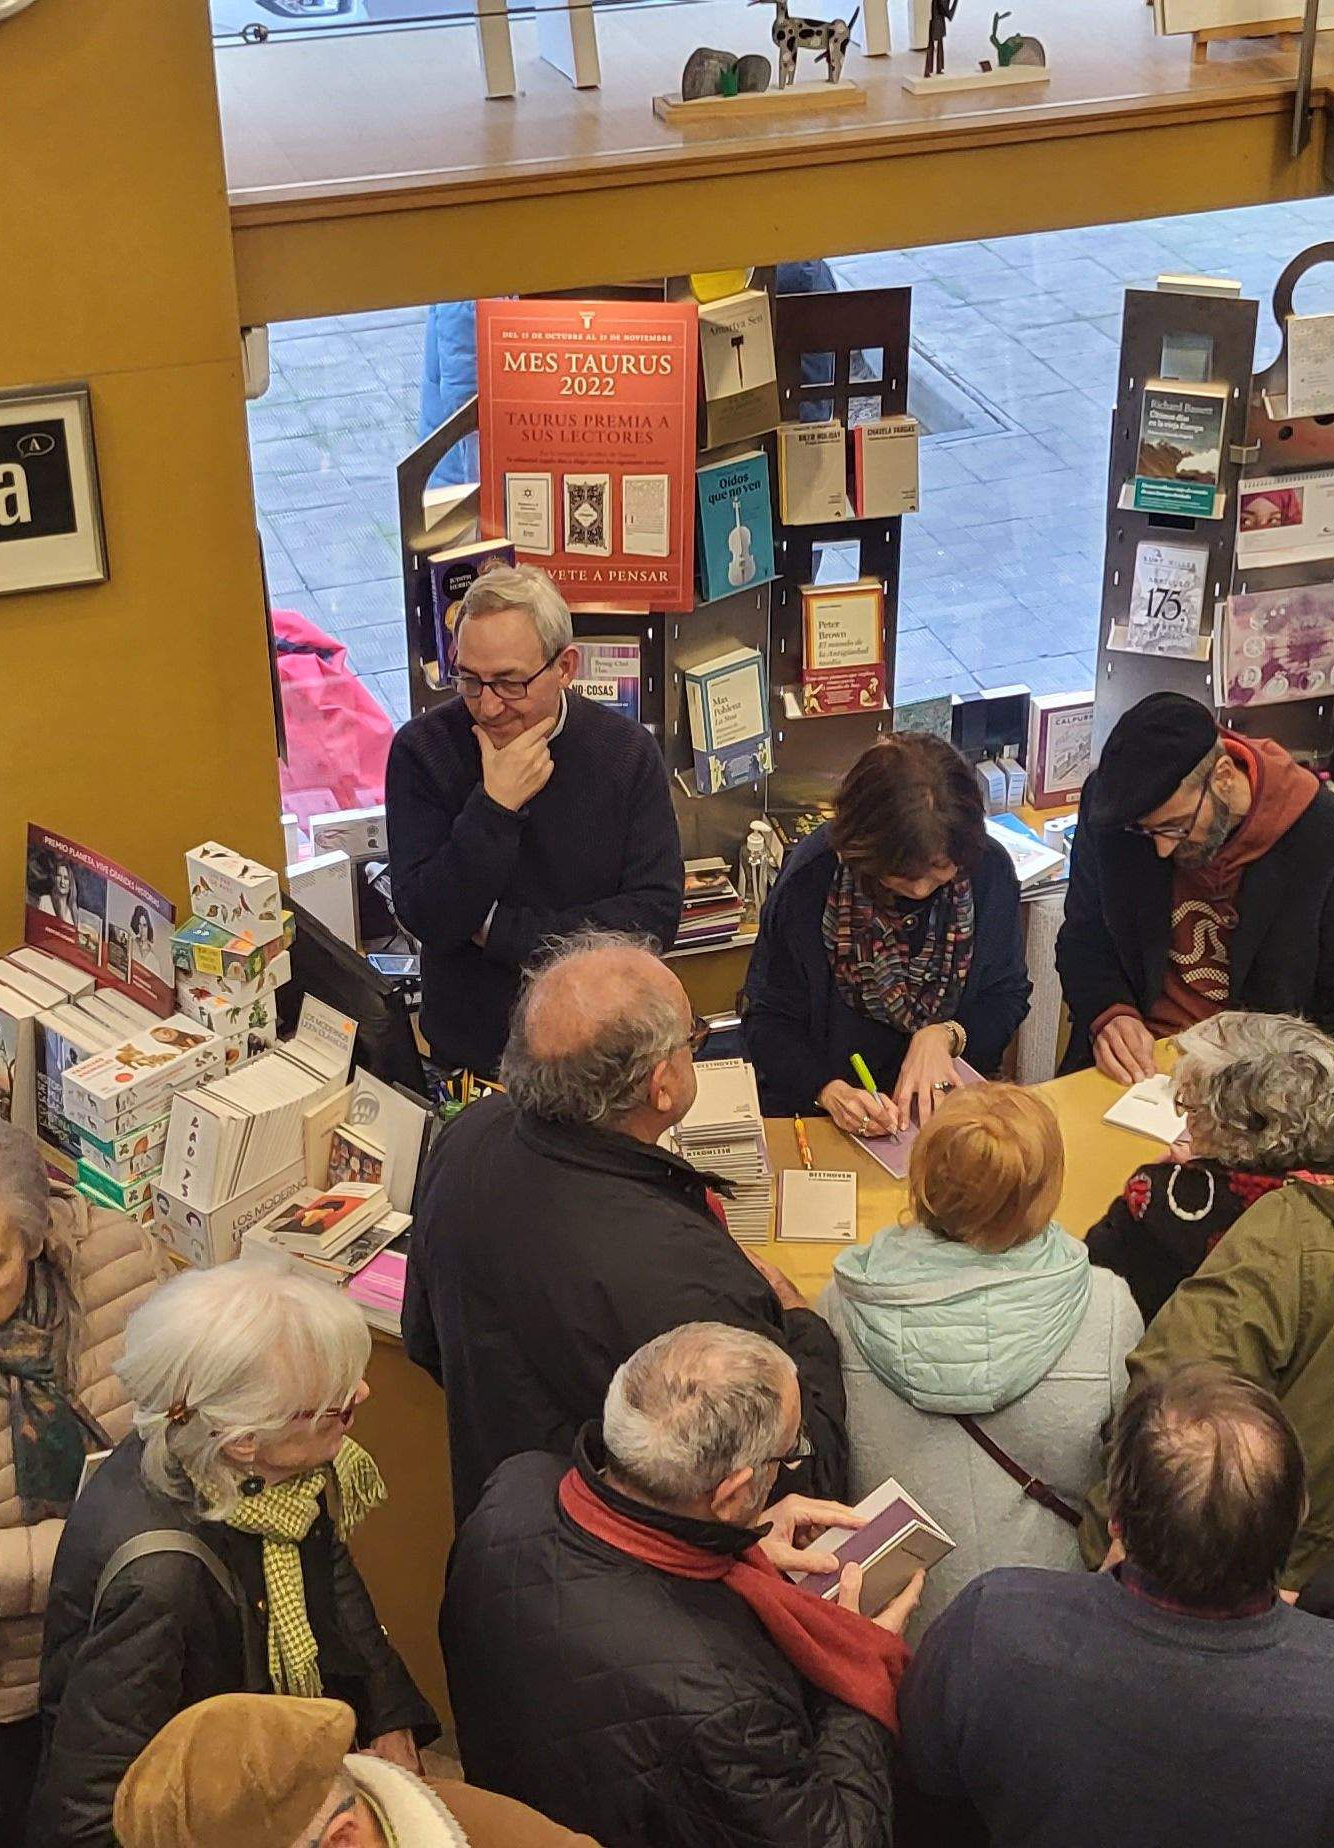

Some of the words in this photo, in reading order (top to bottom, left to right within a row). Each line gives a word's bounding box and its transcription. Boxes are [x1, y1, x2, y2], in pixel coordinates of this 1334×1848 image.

[504, 352, 557, 372] MES
[565, 353, 671, 374] TAURUS
[560, 377, 614, 395] 2022
[506, 413, 576, 427] TAURUS
[584, 414, 652, 428] PREMIA
[657, 417, 670, 429] A
[522, 431, 553, 442] SUS
[561, 431, 653, 444] LECTORES
[743, 480, 761, 494] ven
[594, 570, 603, 582] A
[609, 571, 668, 582] PENSAR
[819, 630, 846, 639] Brown
[44, 836, 68, 852] PREMIO
[96, 861, 109, 874] VIVE
[232, 1212, 252, 1230] LOS
